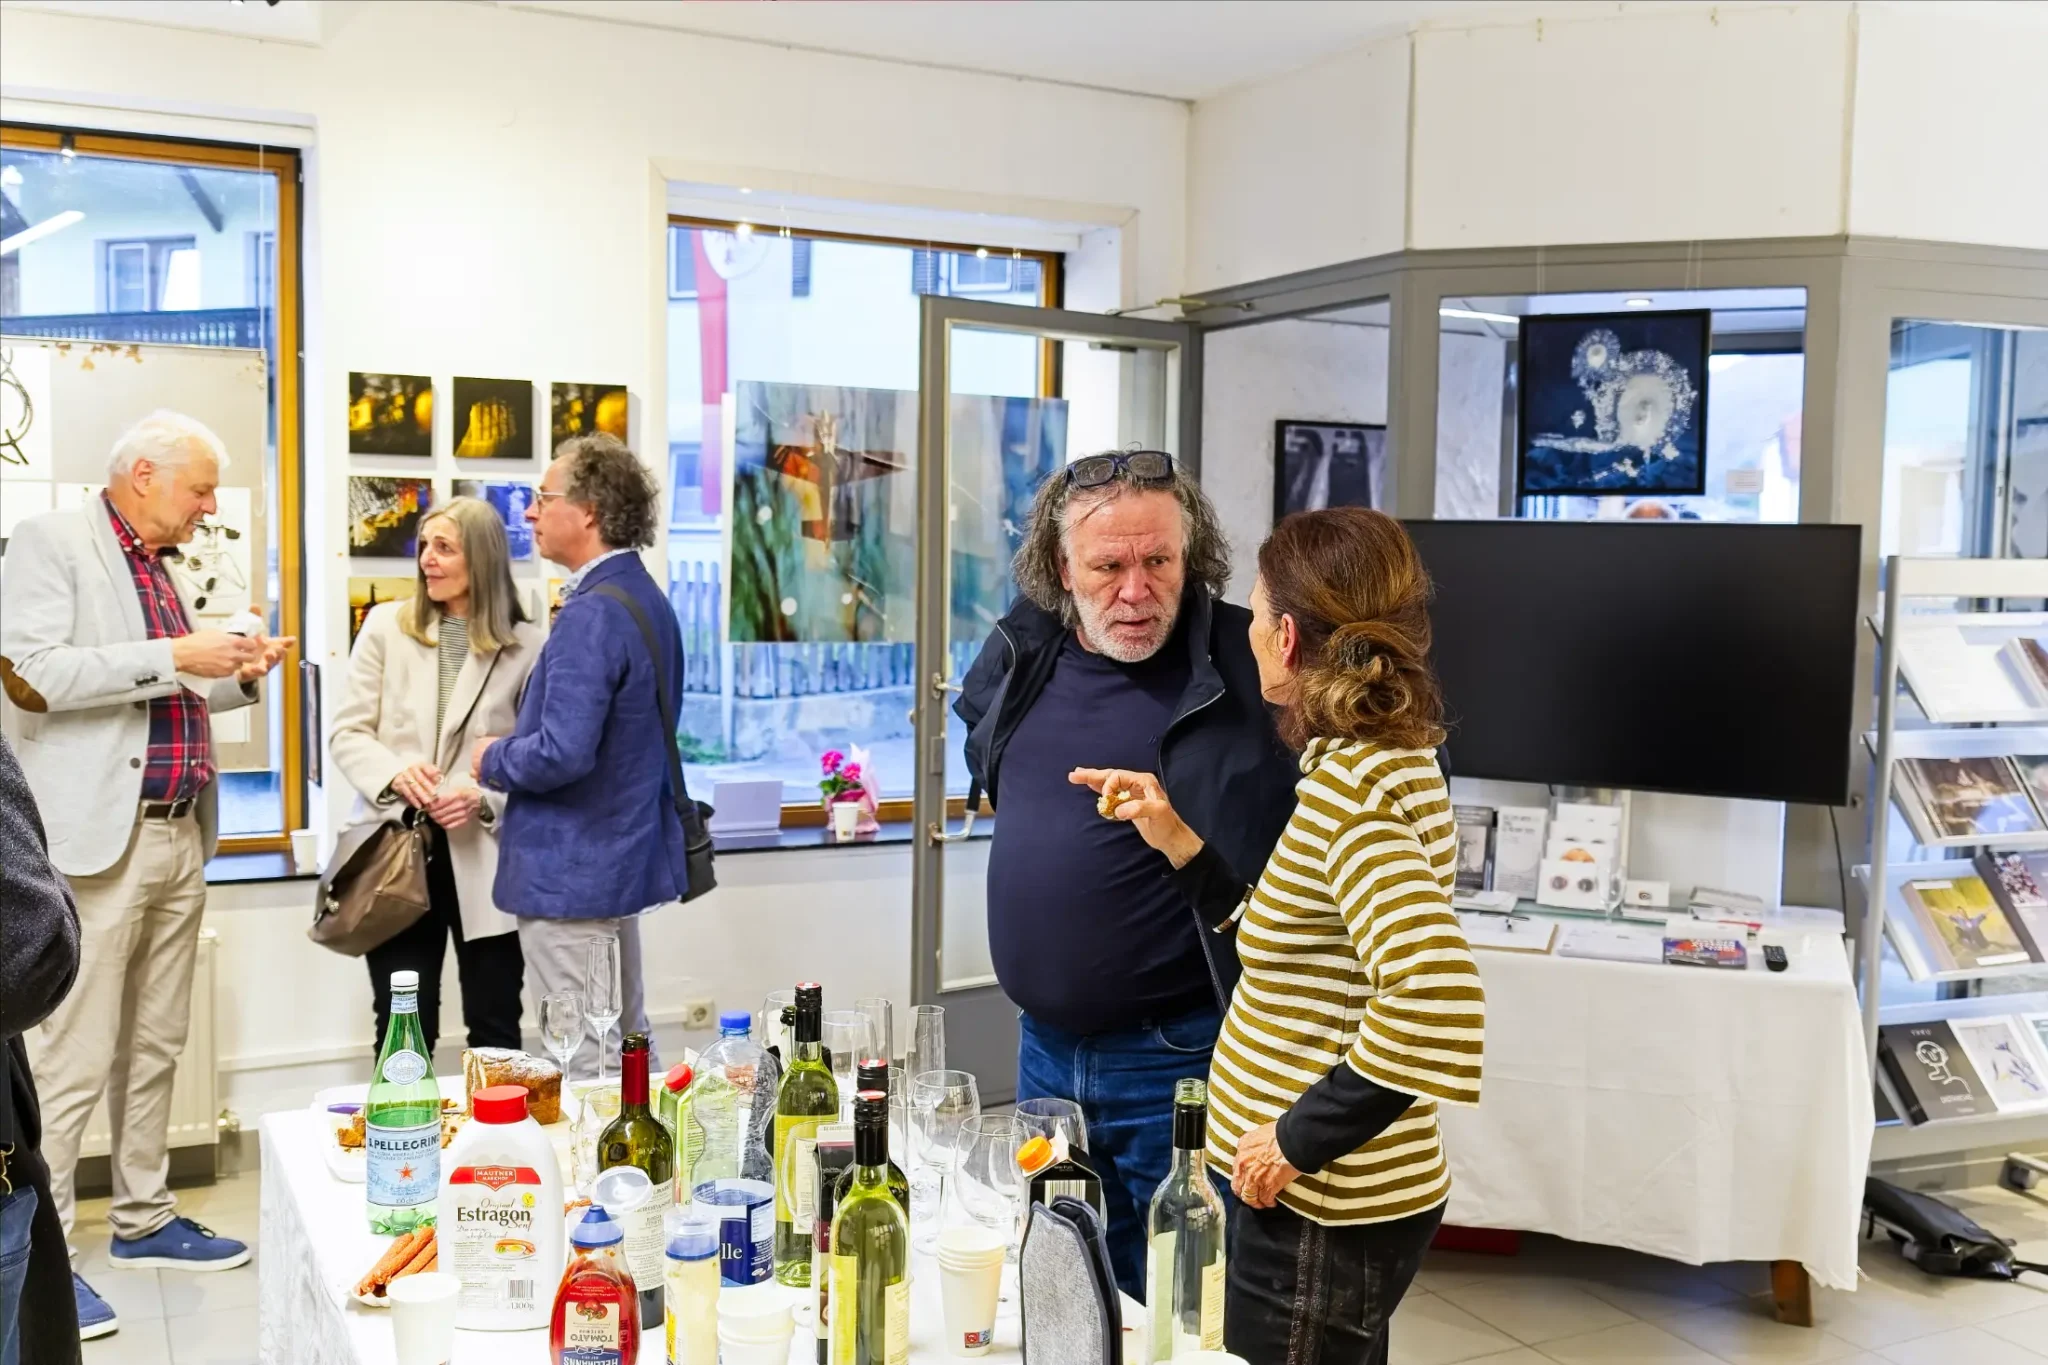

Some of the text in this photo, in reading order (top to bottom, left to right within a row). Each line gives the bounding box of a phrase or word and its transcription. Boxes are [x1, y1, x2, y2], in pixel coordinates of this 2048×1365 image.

[481, 1197, 516, 1210] Original
[457, 1206, 531, 1227] Estragon
[507, 1216, 535, 1233] Senf
[721, 1242, 743, 1260] lle
[570, 1333, 614, 1343] TOMATO
